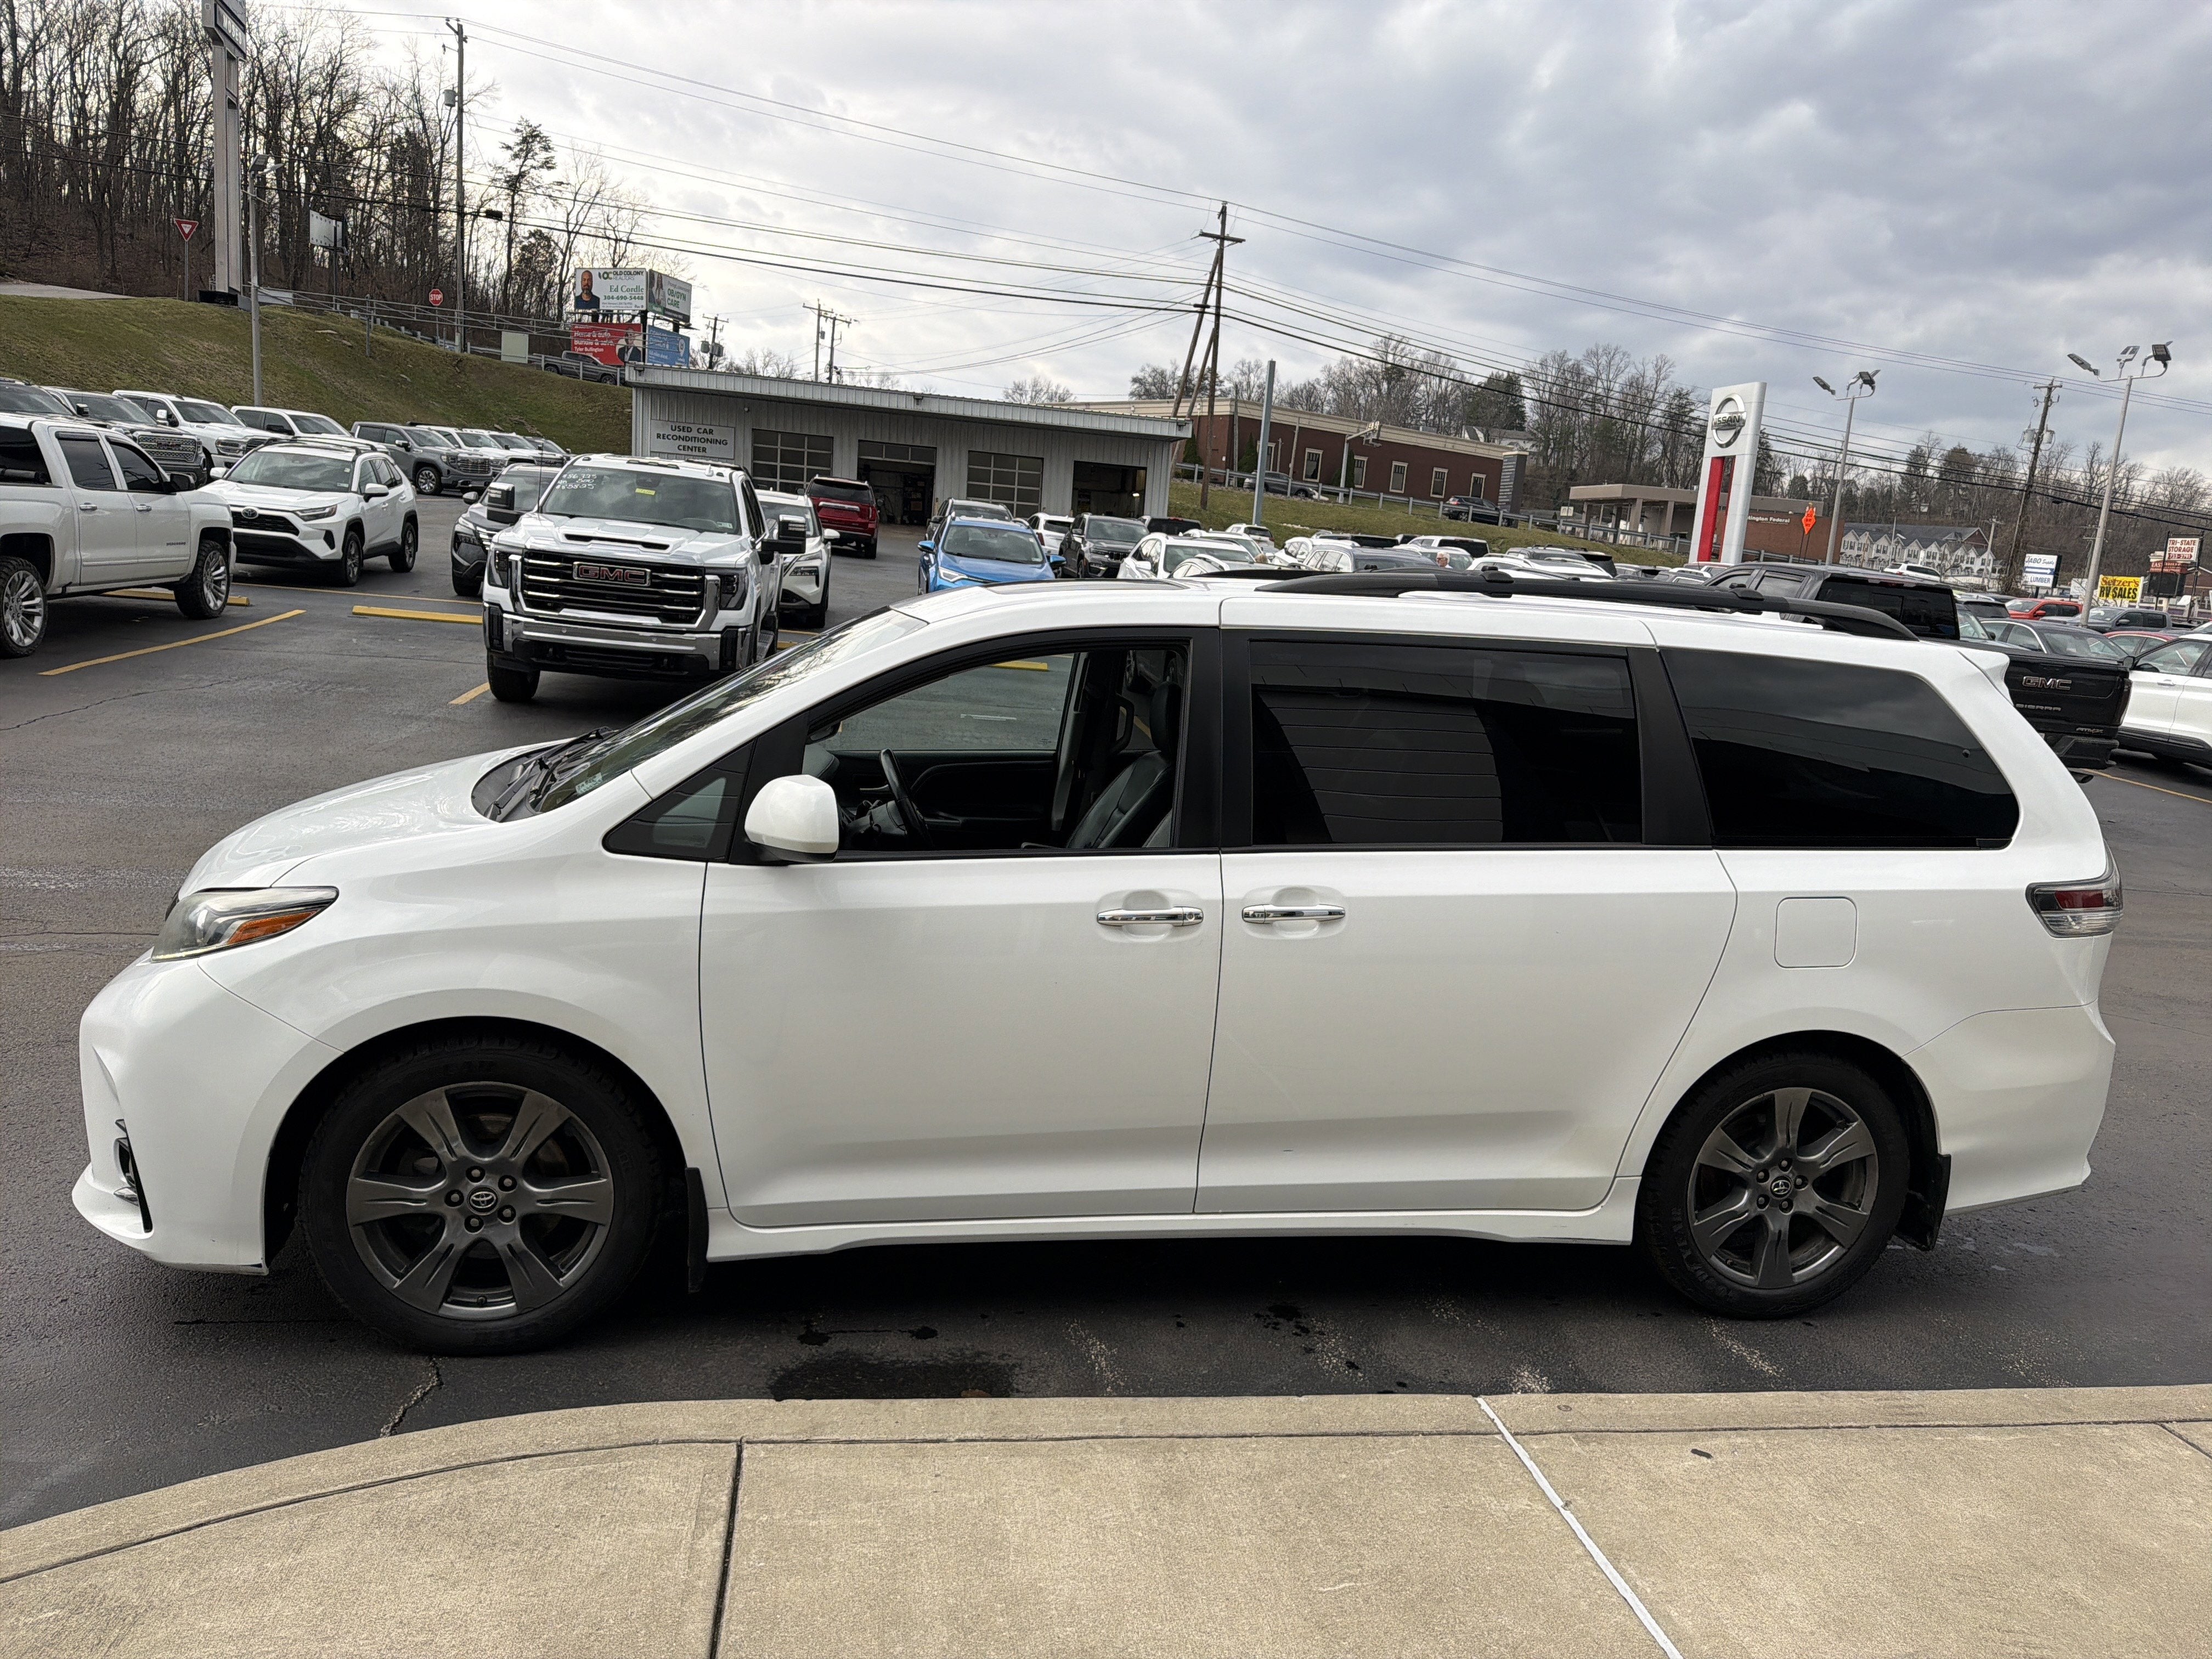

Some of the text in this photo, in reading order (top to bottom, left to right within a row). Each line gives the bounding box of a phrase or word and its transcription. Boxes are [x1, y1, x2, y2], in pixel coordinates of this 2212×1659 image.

[667, 288, 686, 302] OB/GYN
[667, 297, 680, 309] CARE
[670, 425, 714, 435] USED CAR
[656, 432, 728, 446] RECONDITIONING
[677, 444, 707, 453] CENTER
[579, 565, 645, 583] GMC
[2101, 577, 2140, 587] Setzer's
[2099, 586, 2138, 599] RV SALES
[2022, 675, 2072, 690] GMC
[2016, 703, 2062, 712] SIERRA
